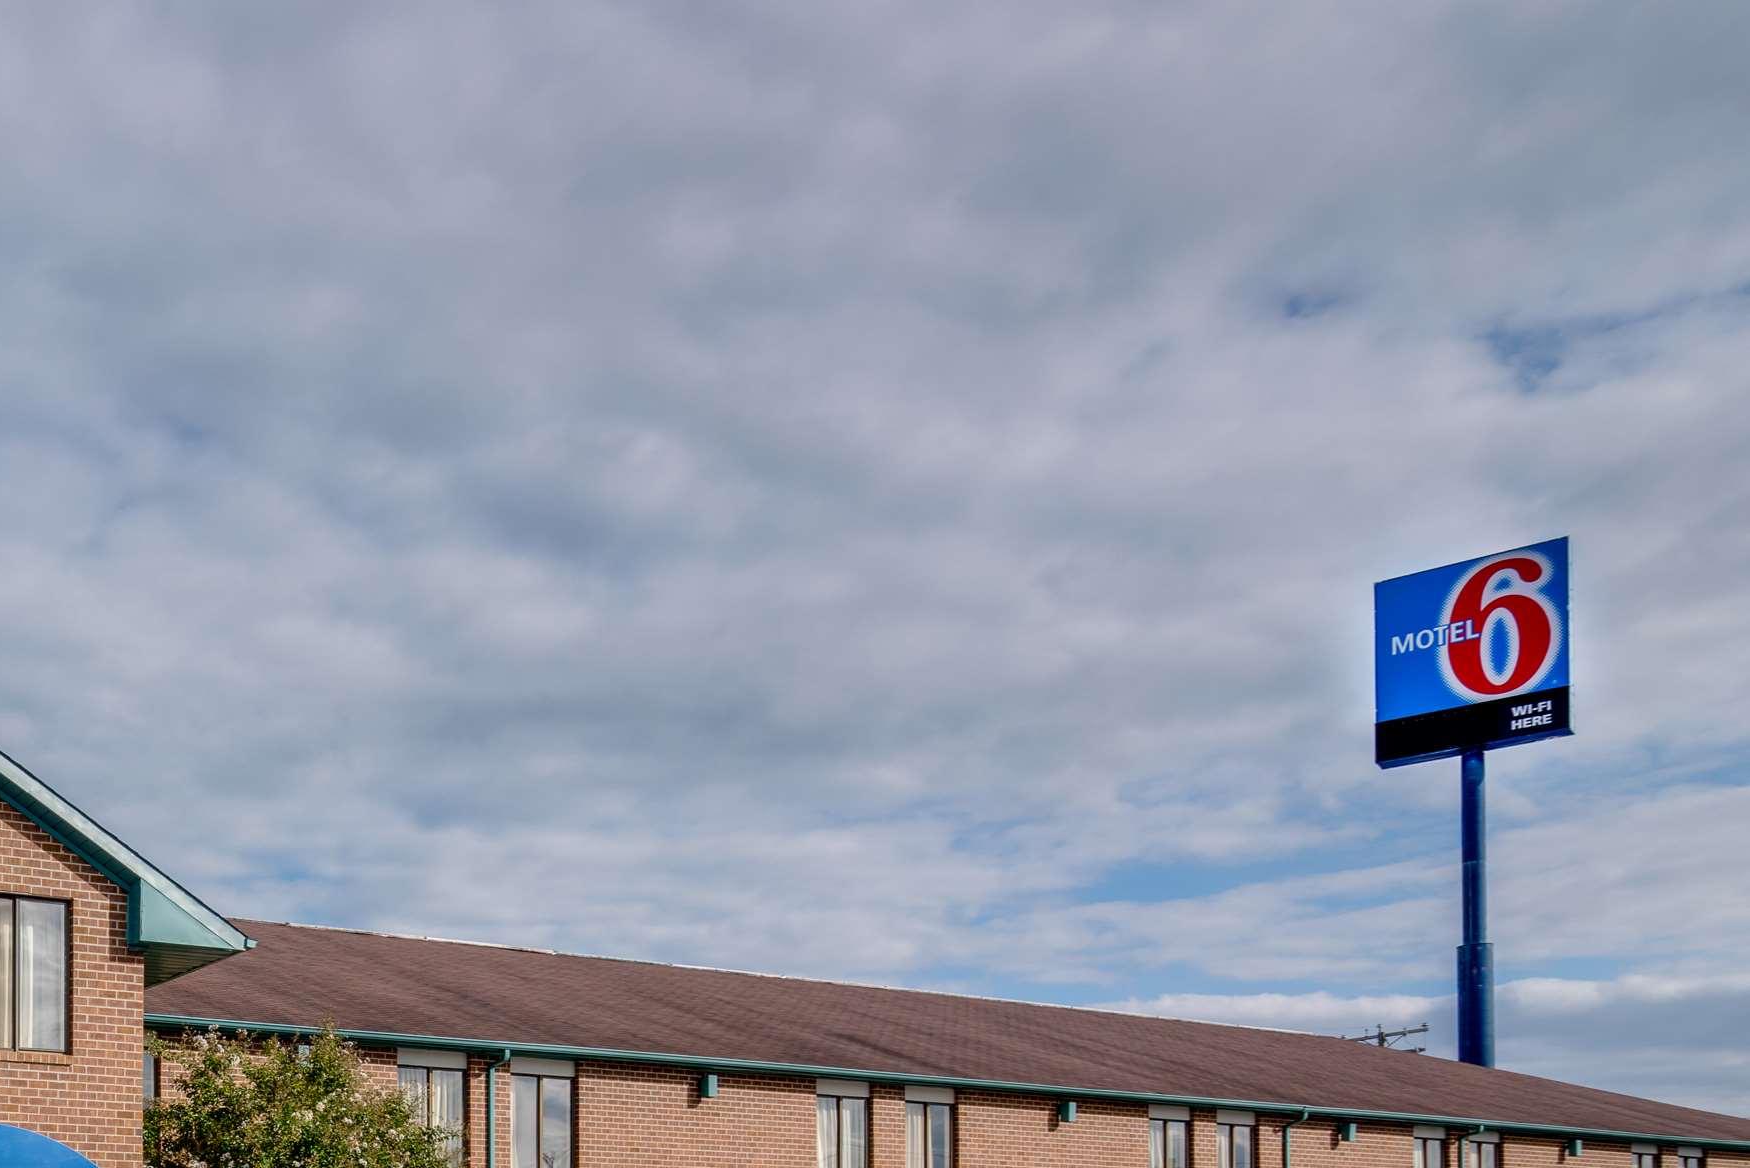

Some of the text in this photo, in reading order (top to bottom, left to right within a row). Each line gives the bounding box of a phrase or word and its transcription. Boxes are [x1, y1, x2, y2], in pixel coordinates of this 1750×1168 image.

[1391, 557, 1551, 695] MOTEL 6
[1511, 700, 1552, 717] WI-FI
[1511, 713, 1552, 731] HERE
